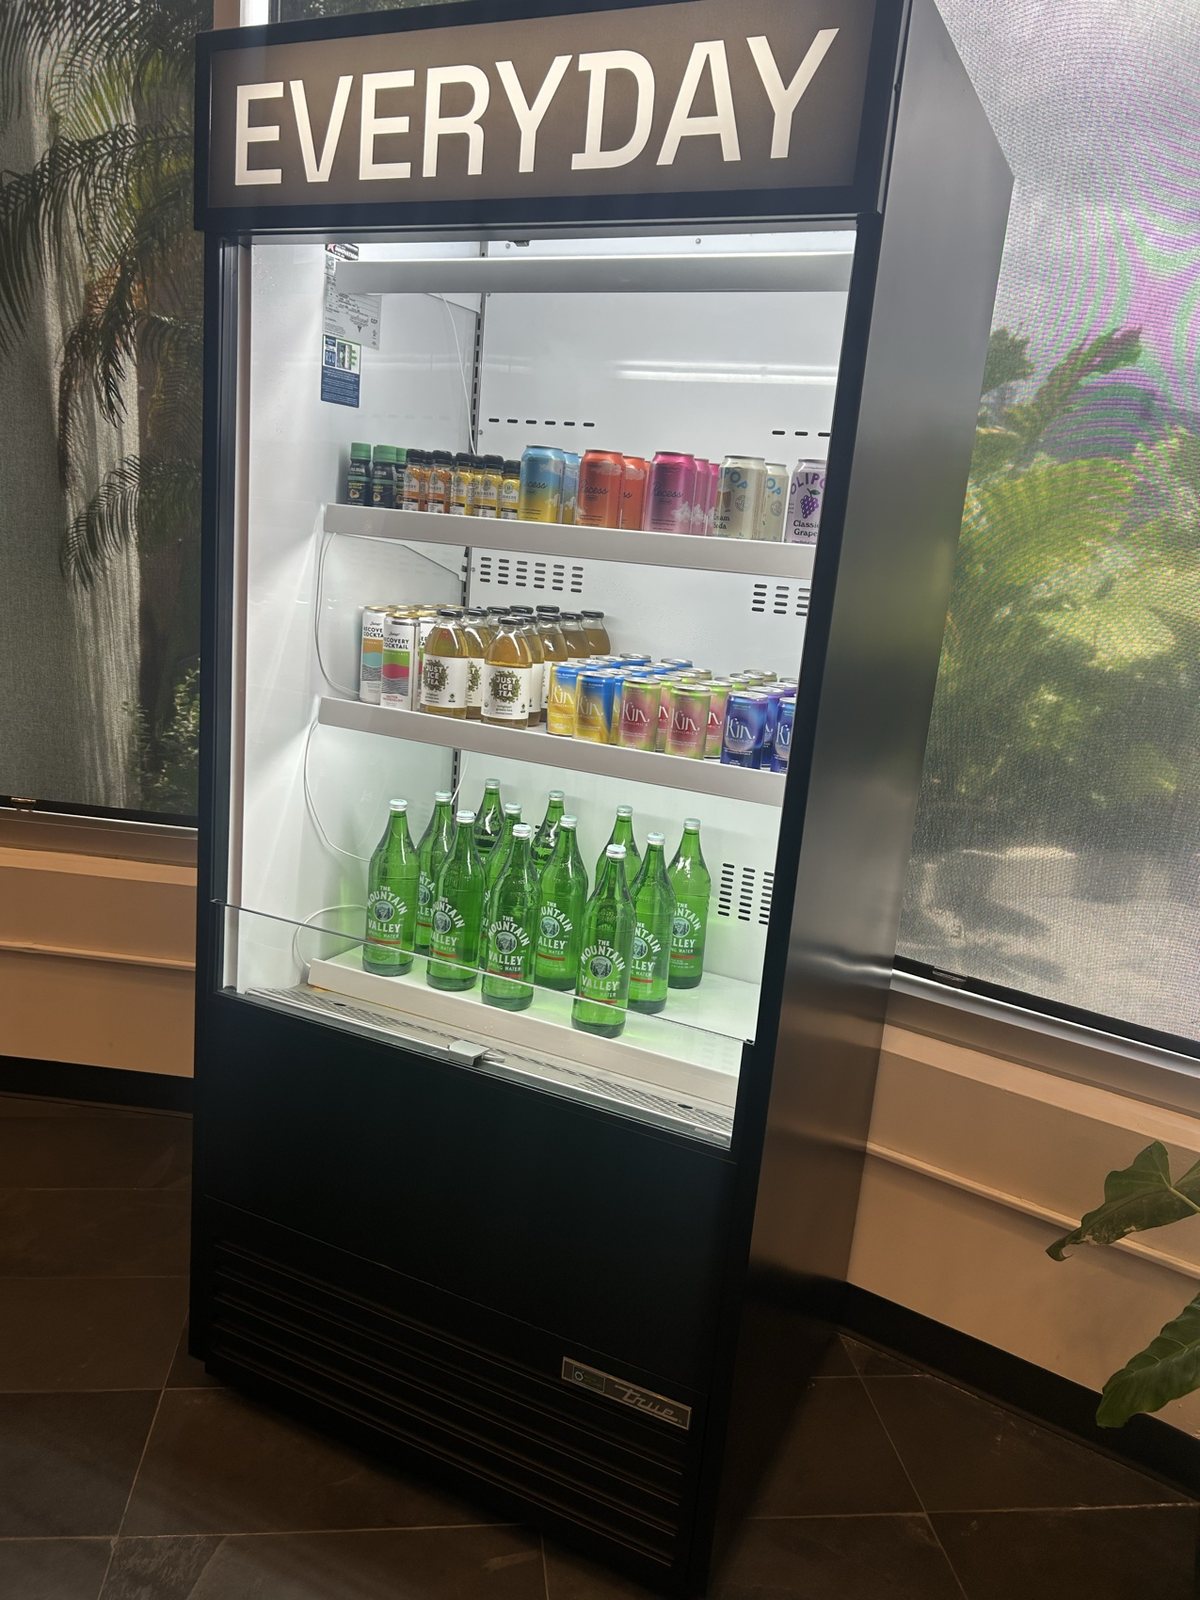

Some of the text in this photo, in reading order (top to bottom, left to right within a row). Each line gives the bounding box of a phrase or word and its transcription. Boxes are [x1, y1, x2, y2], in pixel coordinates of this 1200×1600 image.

[235, 28, 839, 186] EVERYDAY
[790, 472, 826, 495] OLIP
[793, 528, 818, 538] Grape
[426, 665, 444, 673] JUST
[427, 672, 440, 680] ICE
[496, 676, 516, 685] JUST
[367, 891, 408, 915] MOUNTAIN
[368, 918, 402, 933] VALLEY
[541, 906, 573, 932] UNTAIN
[488, 920, 530, 947] MOUNTAIN
[634, 927, 661, 953] NTAIN
[538, 935, 566, 950] ALLEY
[597, 939, 610, 947] THE
[672, 938, 696, 948] LLEY
[489, 951, 523, 966] VALLEY
[580, 945, 626, 972] MOUNTAIN
[581, 975, 620, 991] VALLEY
